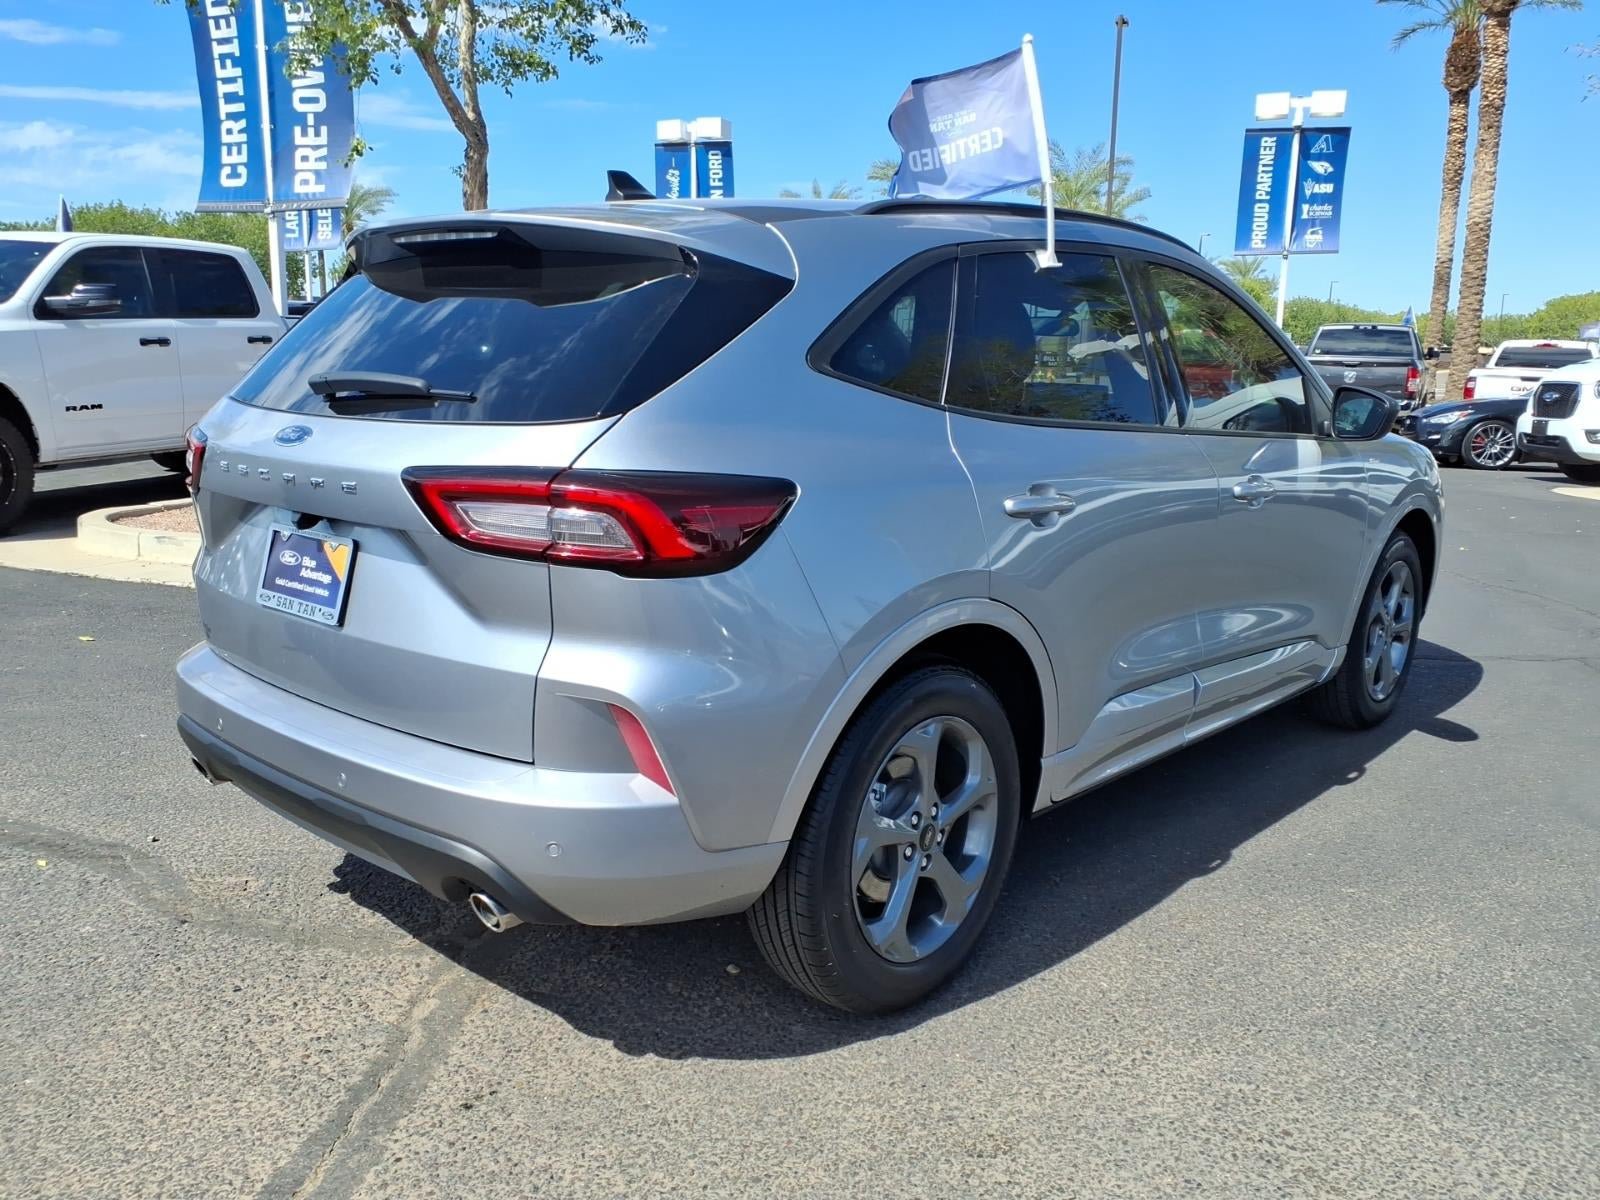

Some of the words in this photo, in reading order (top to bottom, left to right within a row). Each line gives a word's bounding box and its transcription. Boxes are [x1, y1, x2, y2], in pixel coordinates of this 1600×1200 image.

[708, 150, 724, 187] FORD
[1255, 136, 1277, 200] PARTNER
[1312, 183, 1334, 193] ASU
[1251, 202, 1270, 249] PROUD
[65, 403, 103, 412] RAM
[219, 460, 358, 495] ESCAPE
[302, 556, 317, 568] Blue
[287, 581, 304, 590] Certified
[299, 567, 332, 585] Advantage
[276, 595, 295, 611] SAN
[297, 601, 317, 617] TAN
